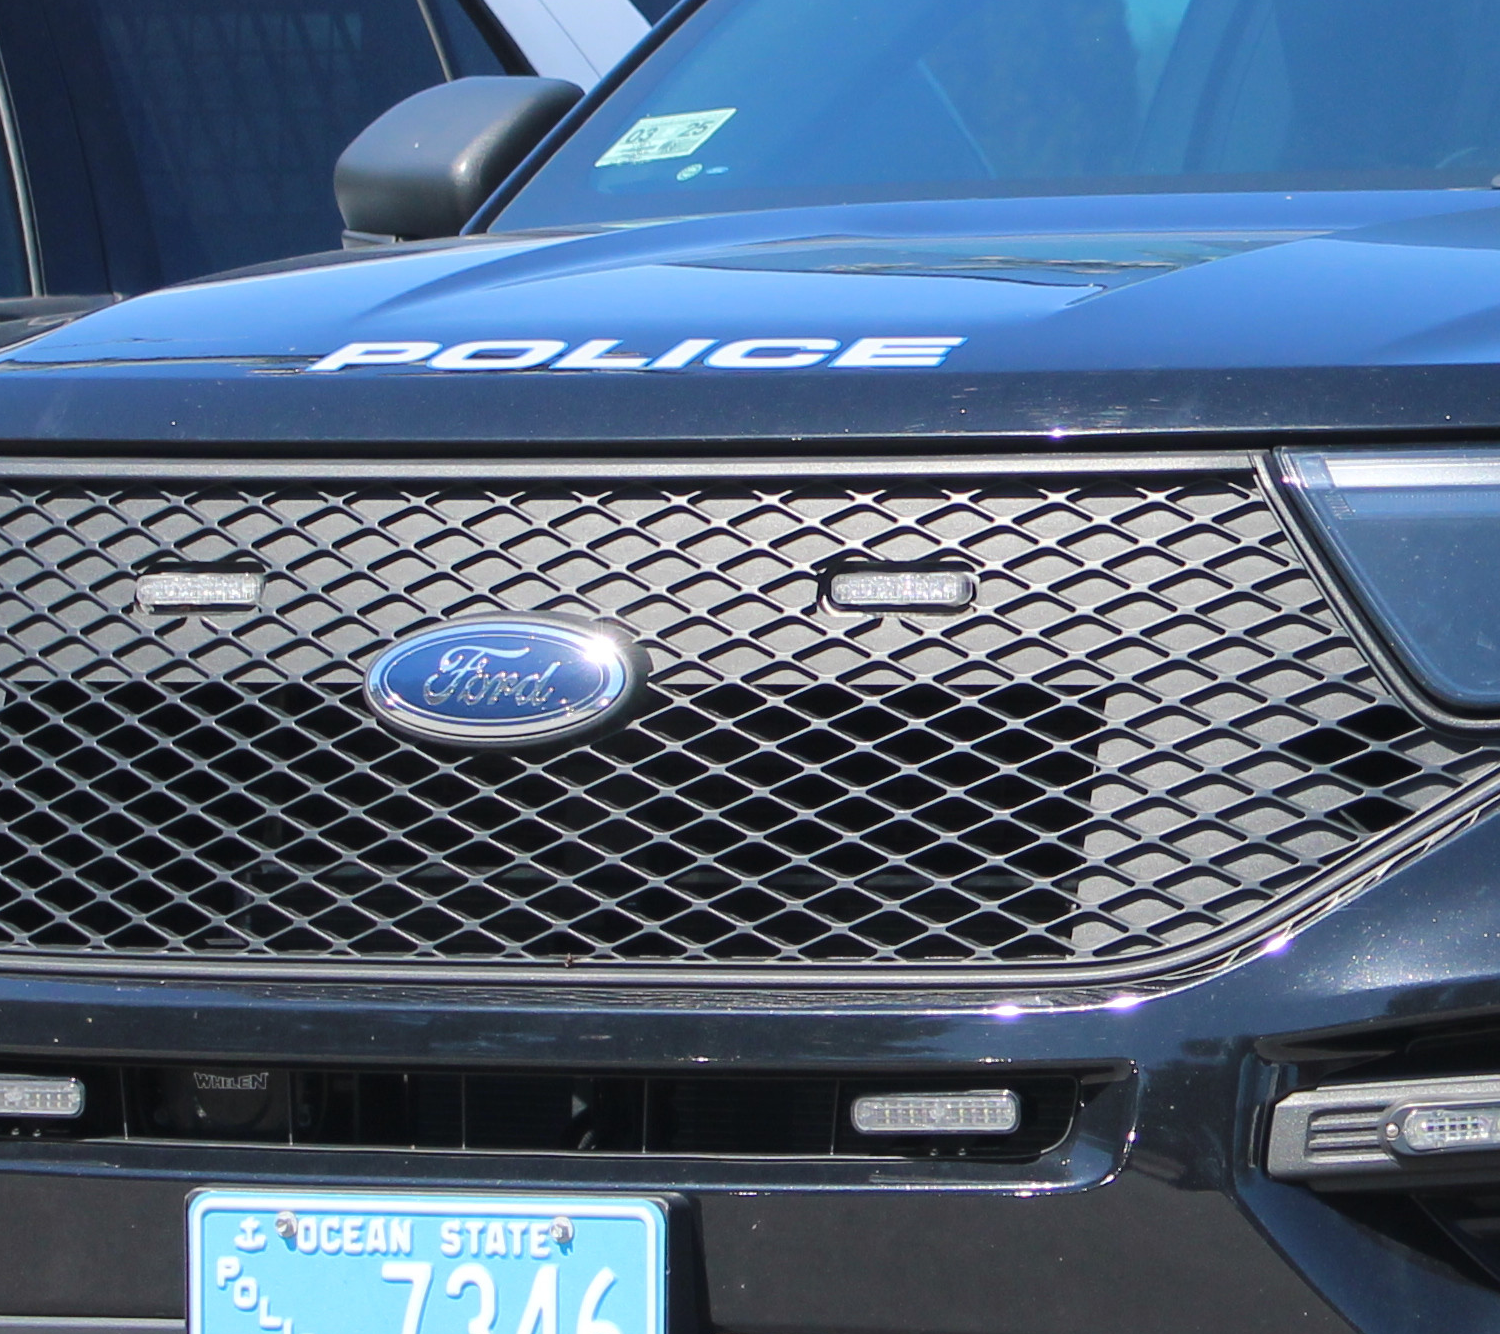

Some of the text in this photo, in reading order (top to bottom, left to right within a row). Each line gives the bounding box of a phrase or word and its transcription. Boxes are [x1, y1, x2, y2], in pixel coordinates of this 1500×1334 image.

[625, 122, 708, 144] 03 25
[308, 337, 967, 369] POLICE
[422, 645, 562, 706] Ford
[192, 1072, 269, 1090] WHELEN
[297, 1217, 552, 1259] OCEAN STATE
